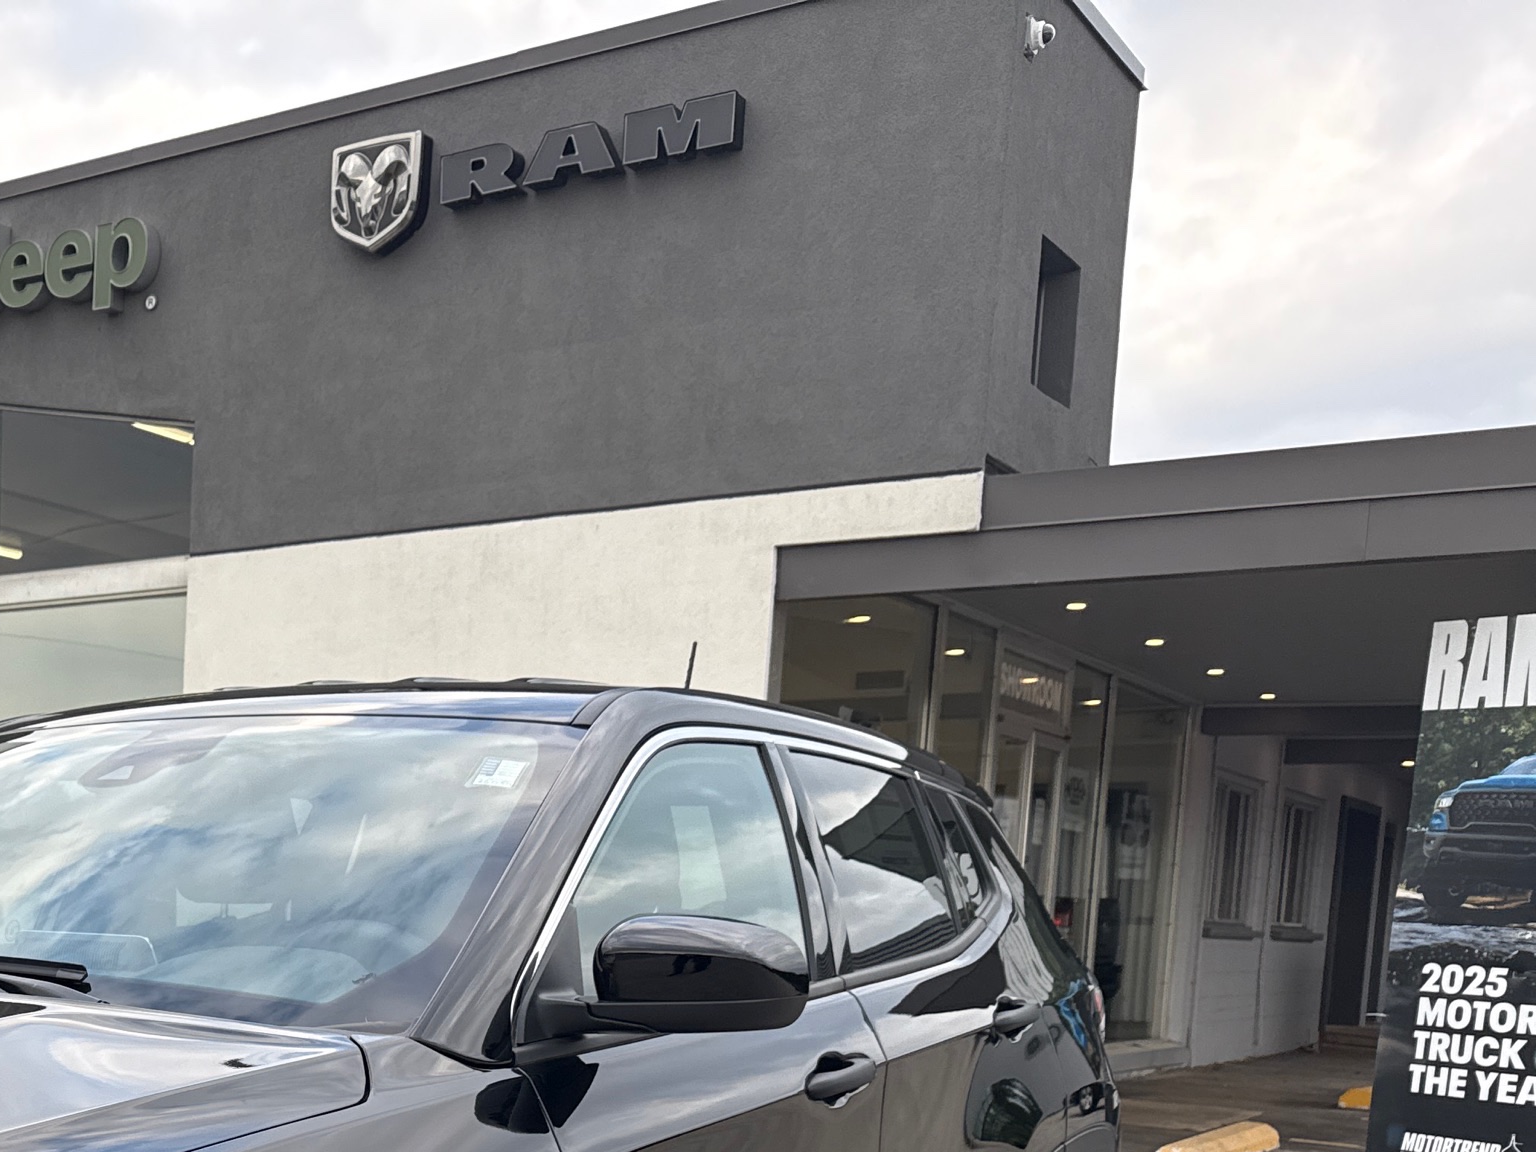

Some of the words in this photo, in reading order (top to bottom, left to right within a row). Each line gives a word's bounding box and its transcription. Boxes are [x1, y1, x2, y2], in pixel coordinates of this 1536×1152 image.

[439, 90, 744, 208] RAM
[1419, 962, 1509, 998] 2025
[1413, 1030, 1528, 1070] TRUCK
[1408, 1063, 1468, 1099] THE
